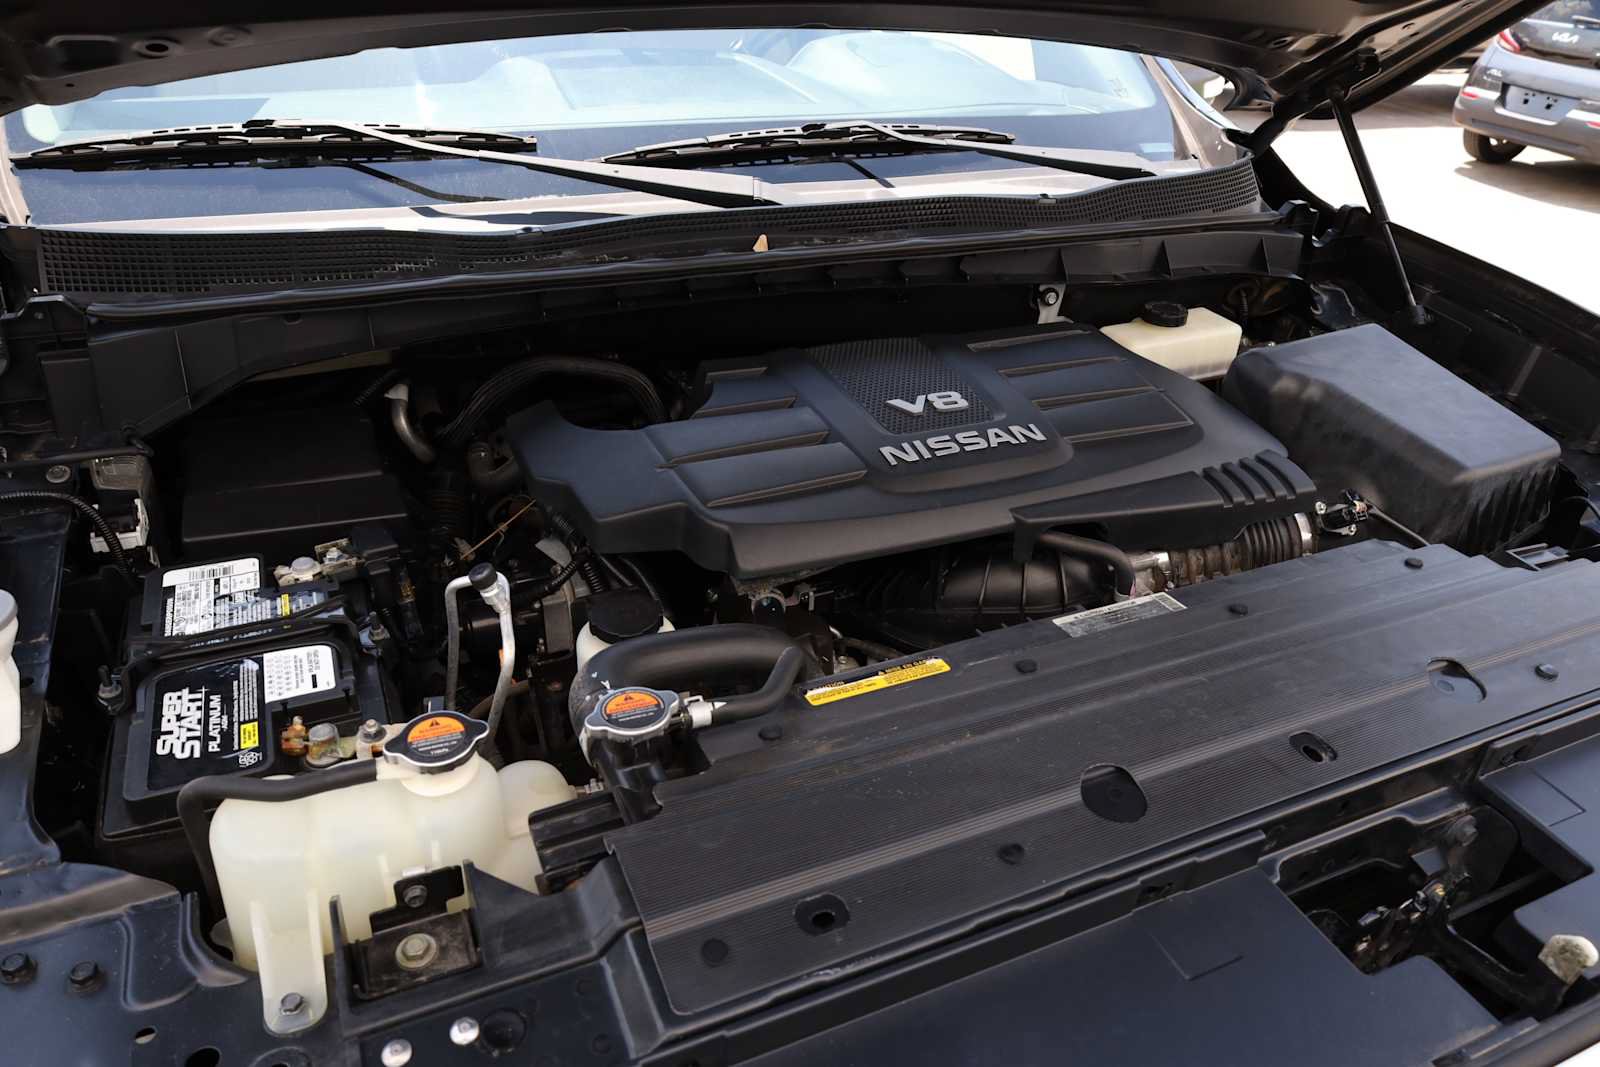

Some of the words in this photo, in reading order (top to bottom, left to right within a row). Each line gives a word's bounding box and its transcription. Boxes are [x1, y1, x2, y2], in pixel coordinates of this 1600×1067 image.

[886, 390, 969, 416] V8
[879, 423, 1048, 466] NISSAN
[156, 690, 182, 756] SUPER
[175, 687, 202, 759] START
[207, 694, 222, 753] PLATINUM
